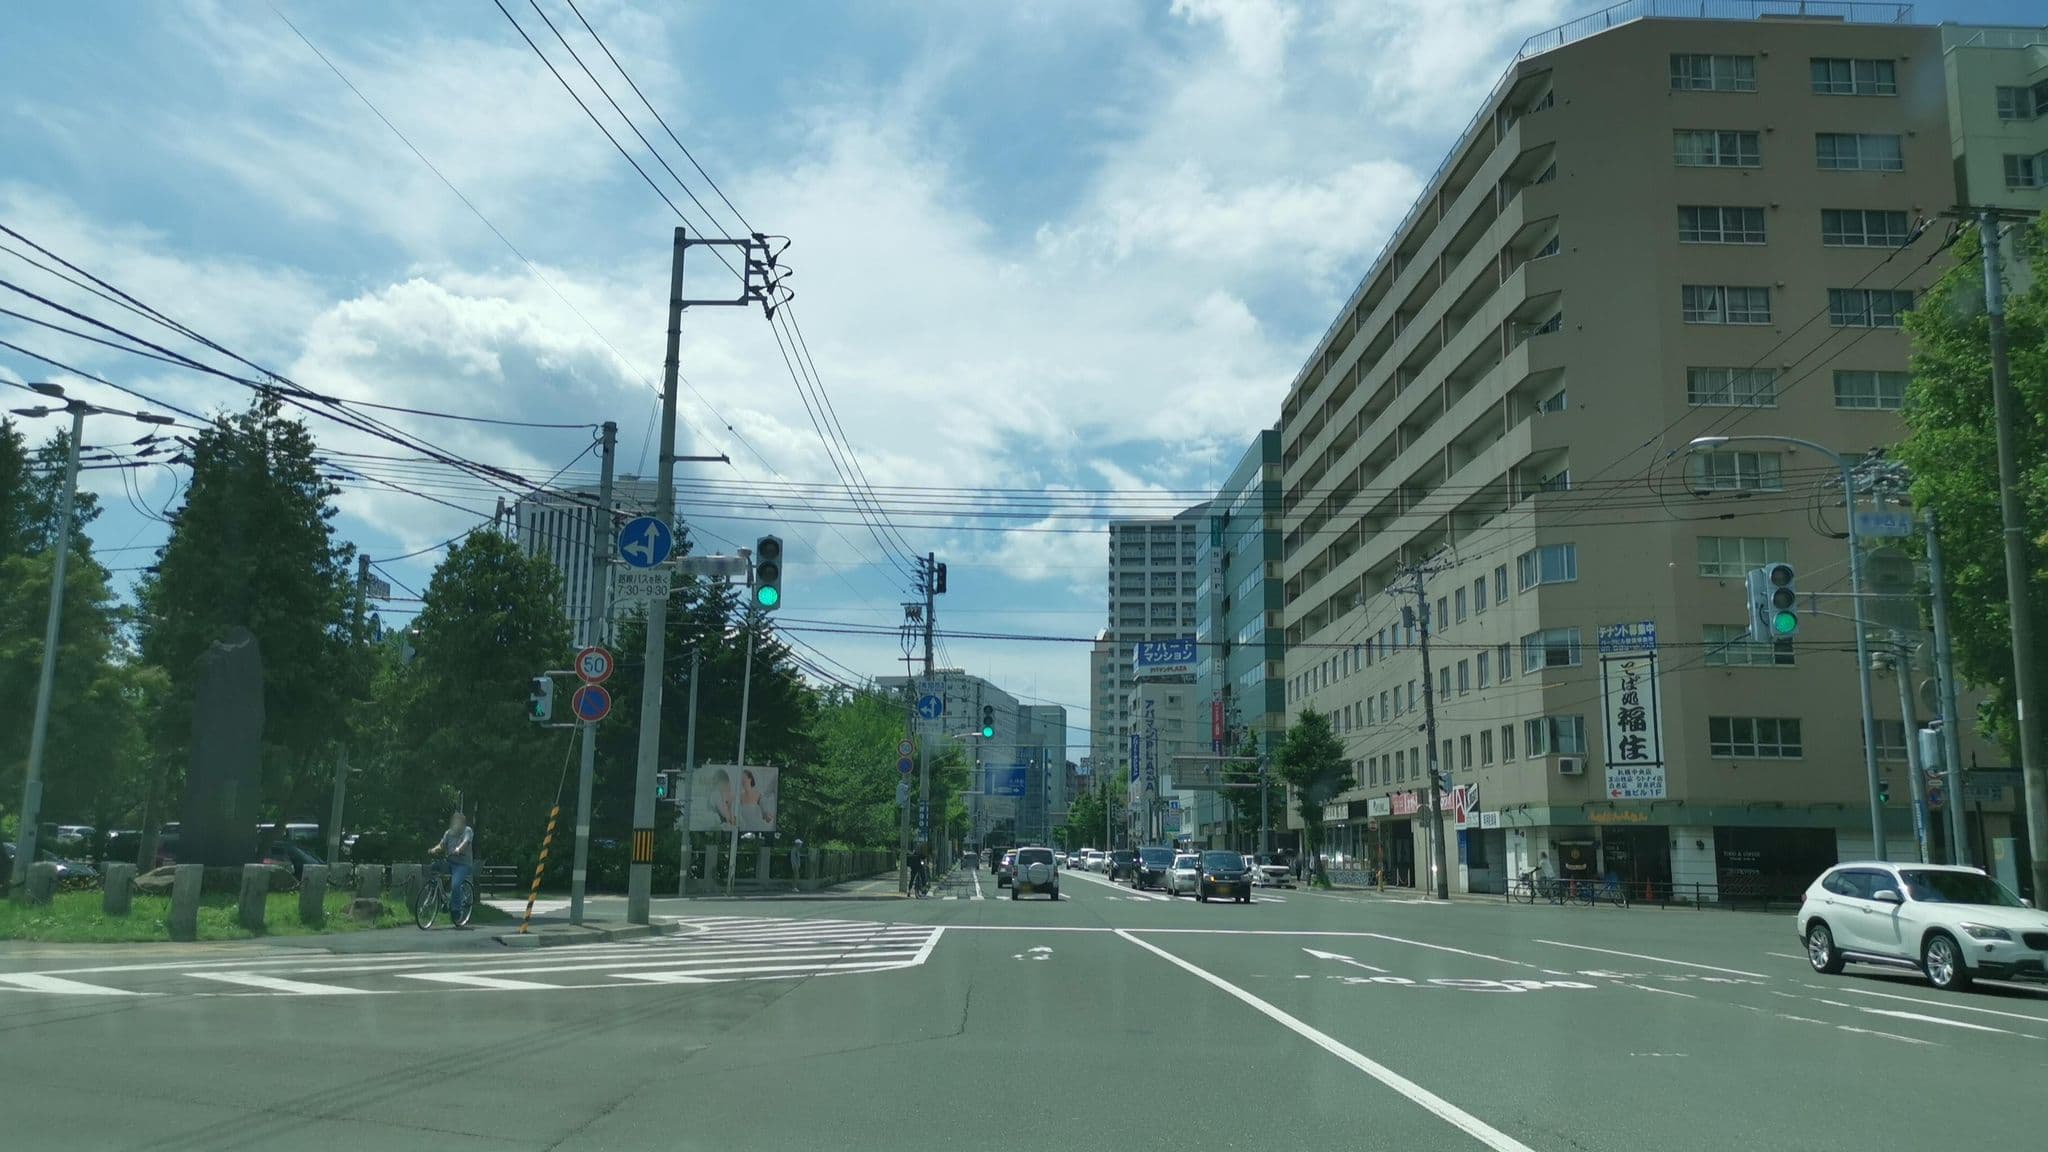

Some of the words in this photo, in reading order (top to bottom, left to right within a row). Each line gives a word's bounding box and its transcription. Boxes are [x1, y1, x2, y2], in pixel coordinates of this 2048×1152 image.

[1144, 651, 1192, 662] マンション
[583, 656, 605, 673] 50
